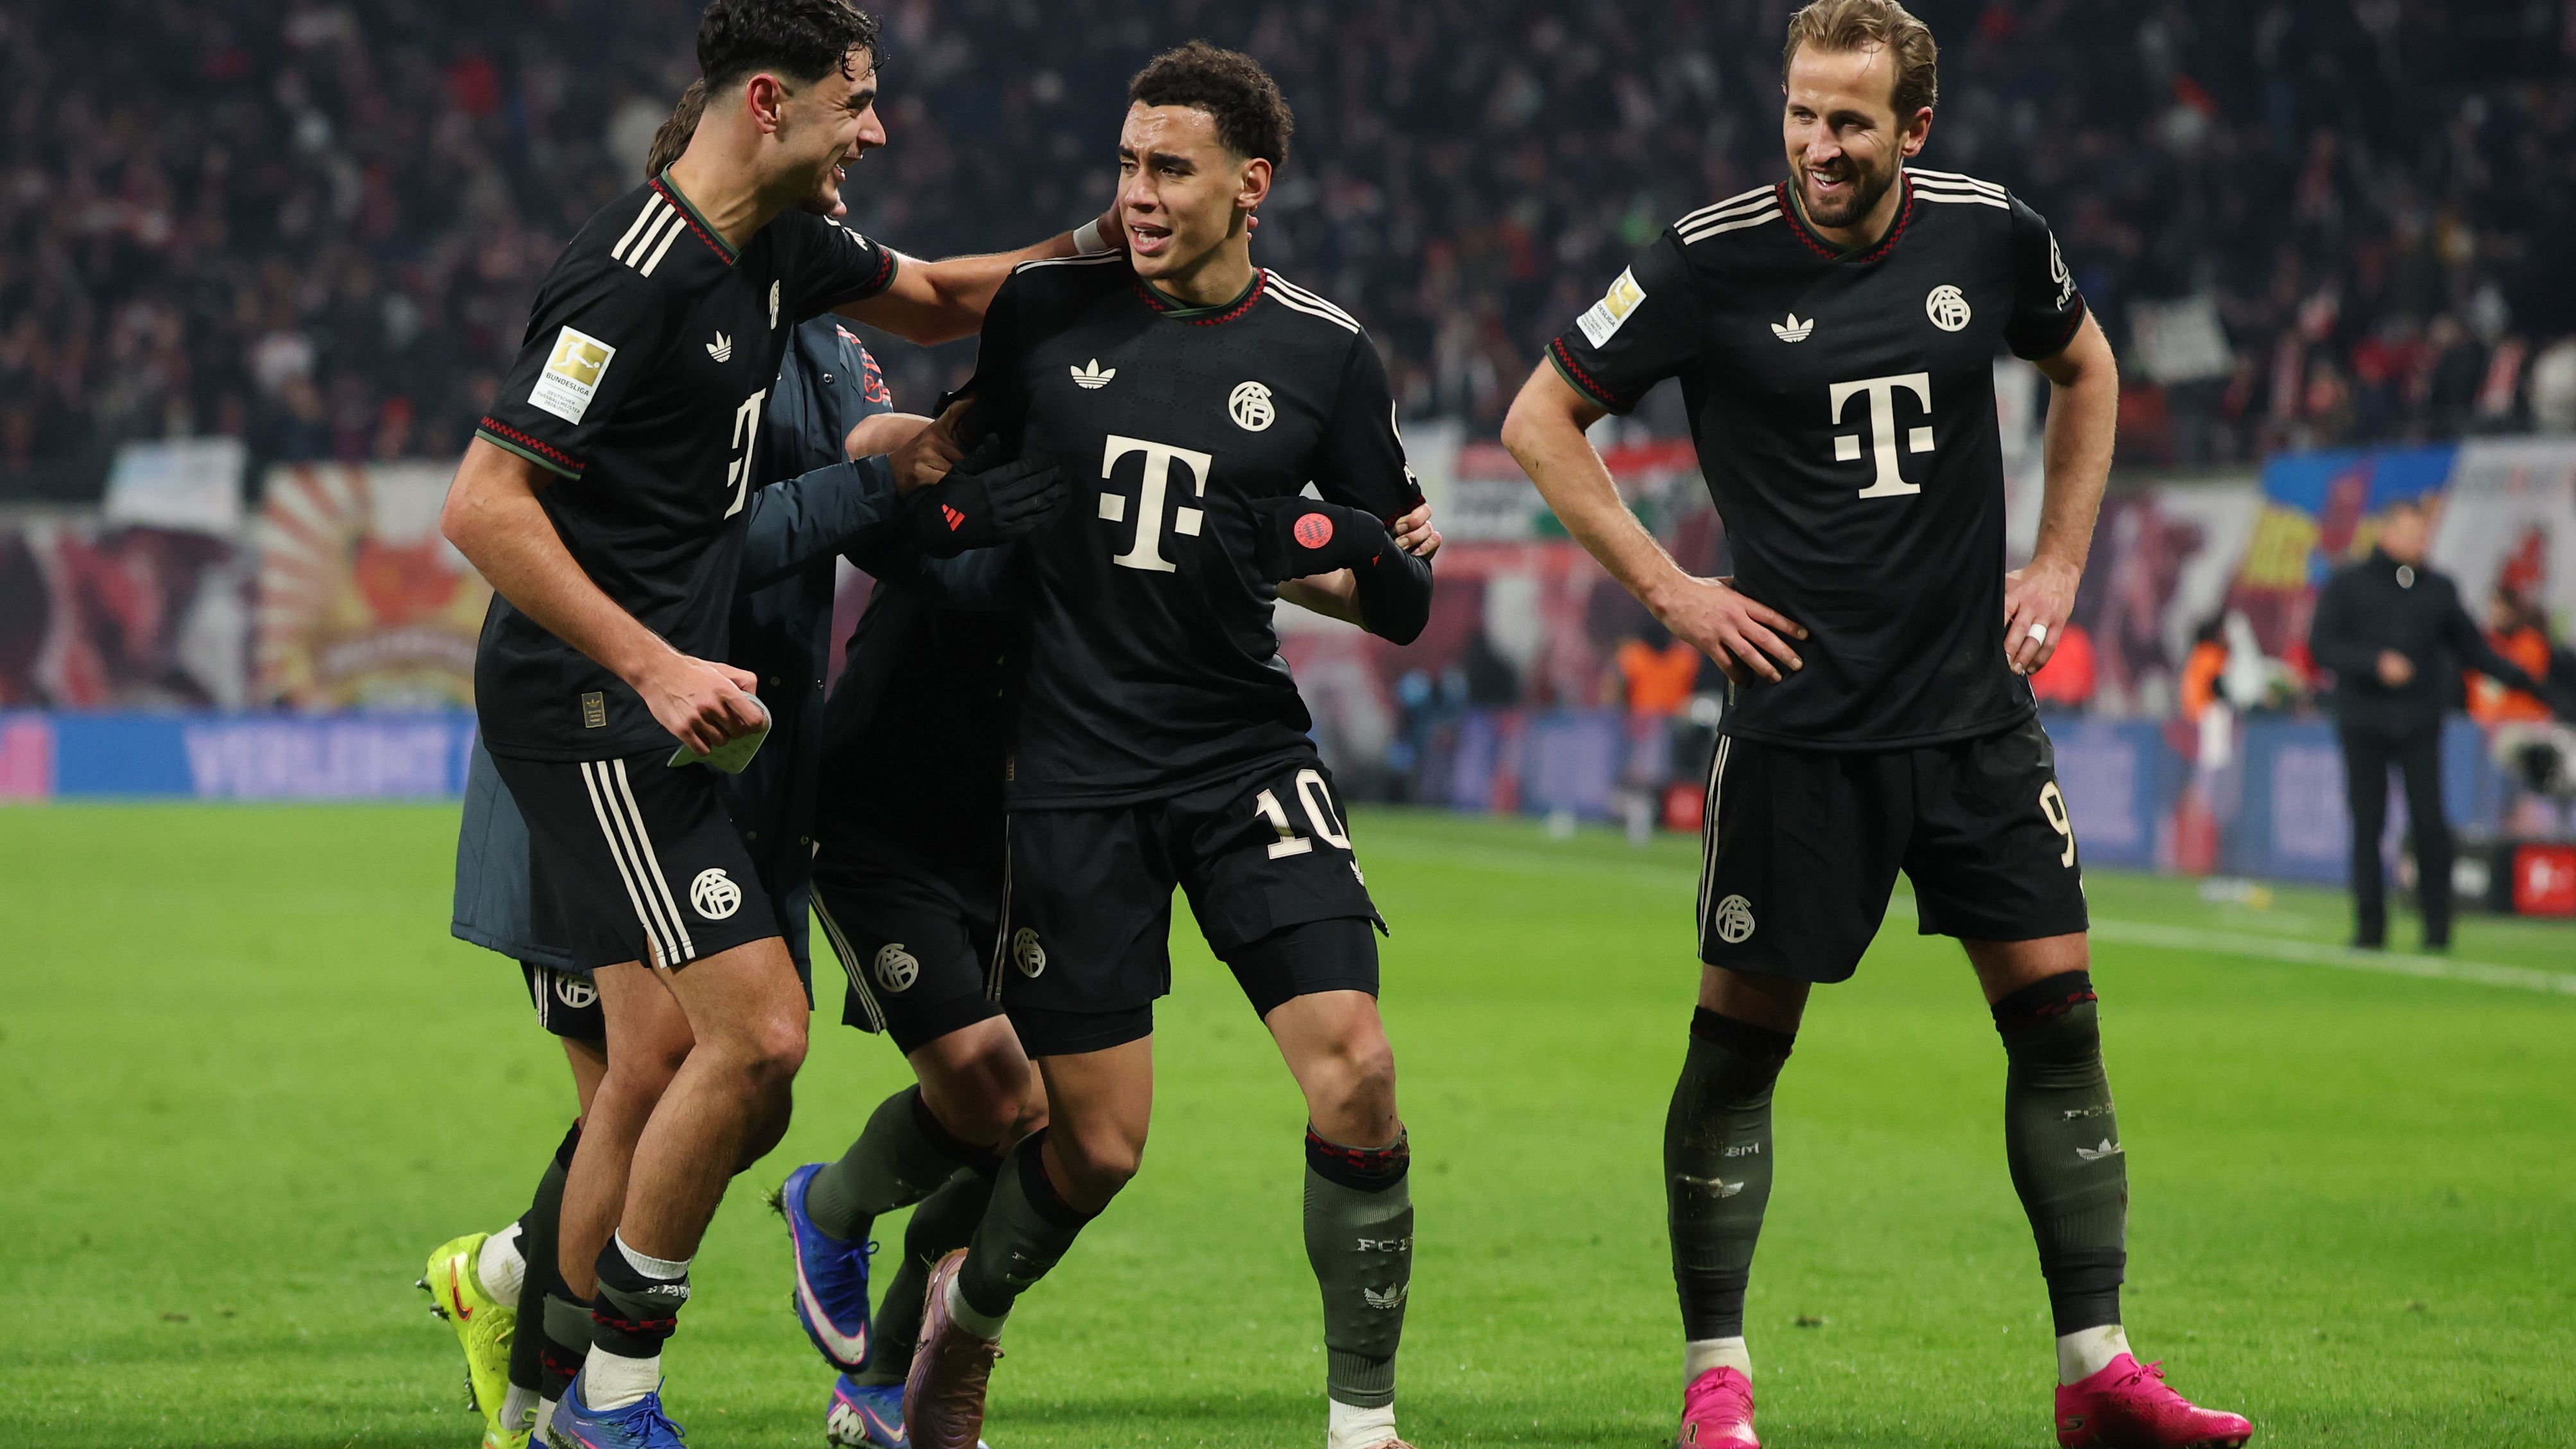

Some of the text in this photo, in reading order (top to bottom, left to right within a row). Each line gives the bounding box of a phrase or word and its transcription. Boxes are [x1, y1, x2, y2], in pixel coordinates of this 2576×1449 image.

[1596, 303, 1615, 327] DESLIGA
[537, 391, 581, 414] FUSSBALLMEISTER
[546, 372, 589, 396] BUNDESLIGA
[547, 390, 576, 406] DEUTSCHER
[1830, 372, 1935, 499] T
[1098, 434, 1212, 573] T
[1254, 769, 1352, 860] 10
[2039, 780, 2074, 868] 9
